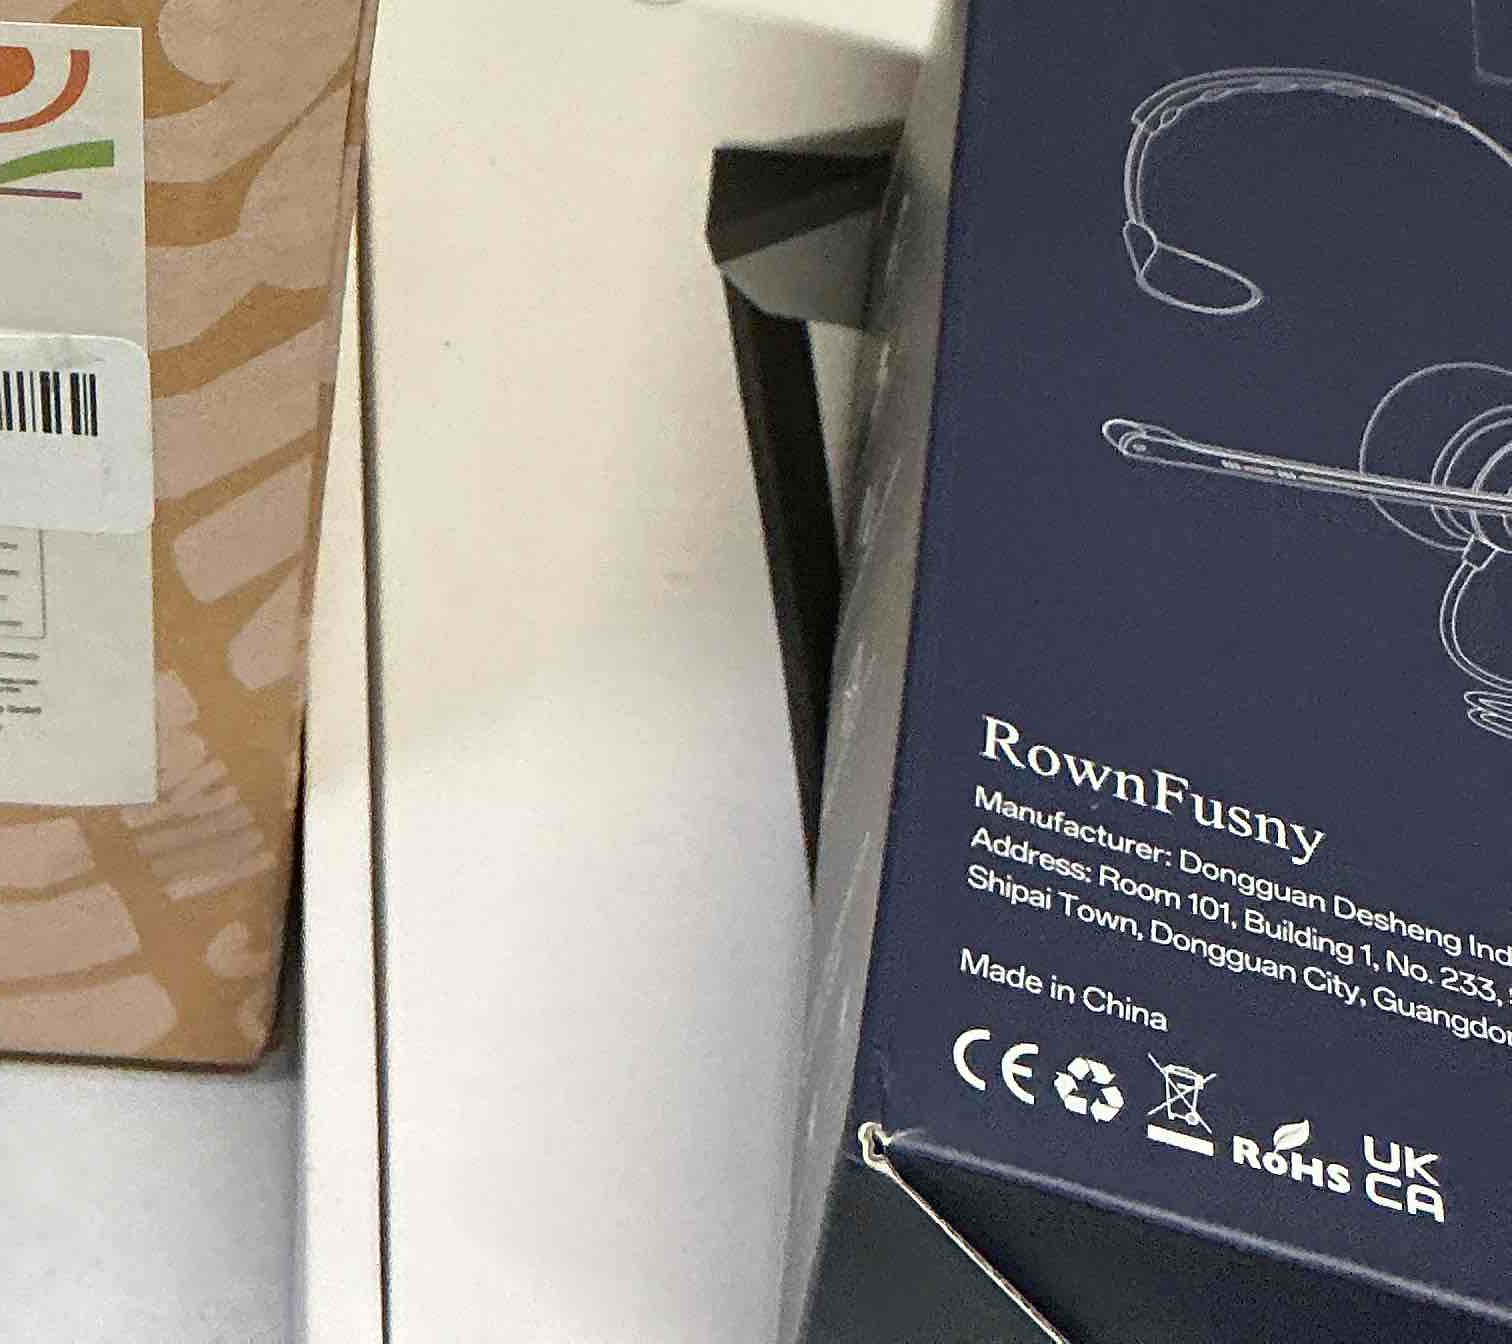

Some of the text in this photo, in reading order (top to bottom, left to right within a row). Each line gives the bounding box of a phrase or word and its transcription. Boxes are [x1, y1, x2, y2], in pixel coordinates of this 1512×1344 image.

[979, 712, 1328, 866] RownFusny
[970, 827, 1503, 1008] Address: Room 101, Building 1, No. 233,
[974, 785, 1172, 869] Manufacturer:
[1179, 848, 1327, 920] Dongguan
[1333, 896, 1464, 957] Desheng
[959, 947, 1170, 1033] Made in China
[966, 864, 1052, 912] Shipai
[1057, 890, 1145, 942] Town,
[1149, 919, 1298, 986] Dongguan
[1302, 965, 1368, 1008] City,
[952, 1028, 1040, 1106] CE
[1362, 1134, 1441, 1188] UK
[1365, 1172, 1447, 1225] CA
